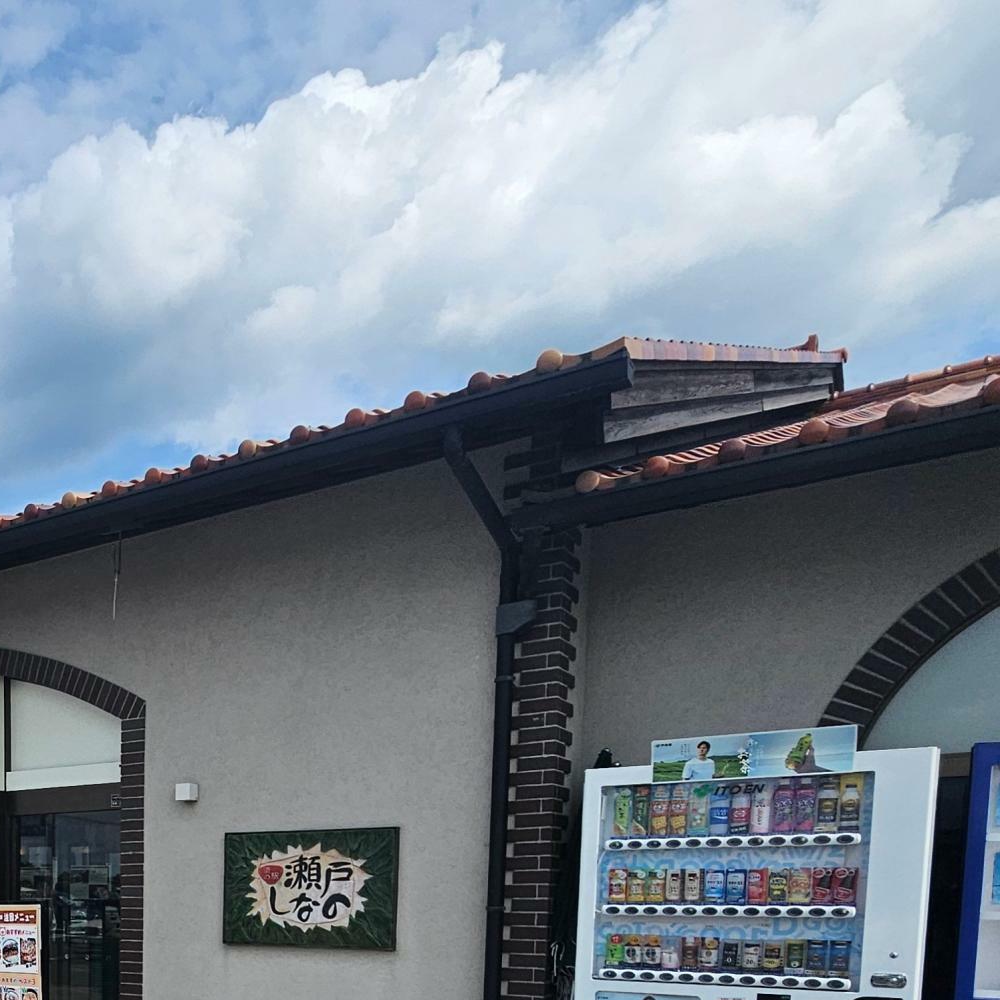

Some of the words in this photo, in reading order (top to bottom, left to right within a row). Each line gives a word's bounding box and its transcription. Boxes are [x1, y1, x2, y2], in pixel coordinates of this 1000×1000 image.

[284, 854, 354, 898] 瀬戸
[269, 886, 351, 922] しなの
